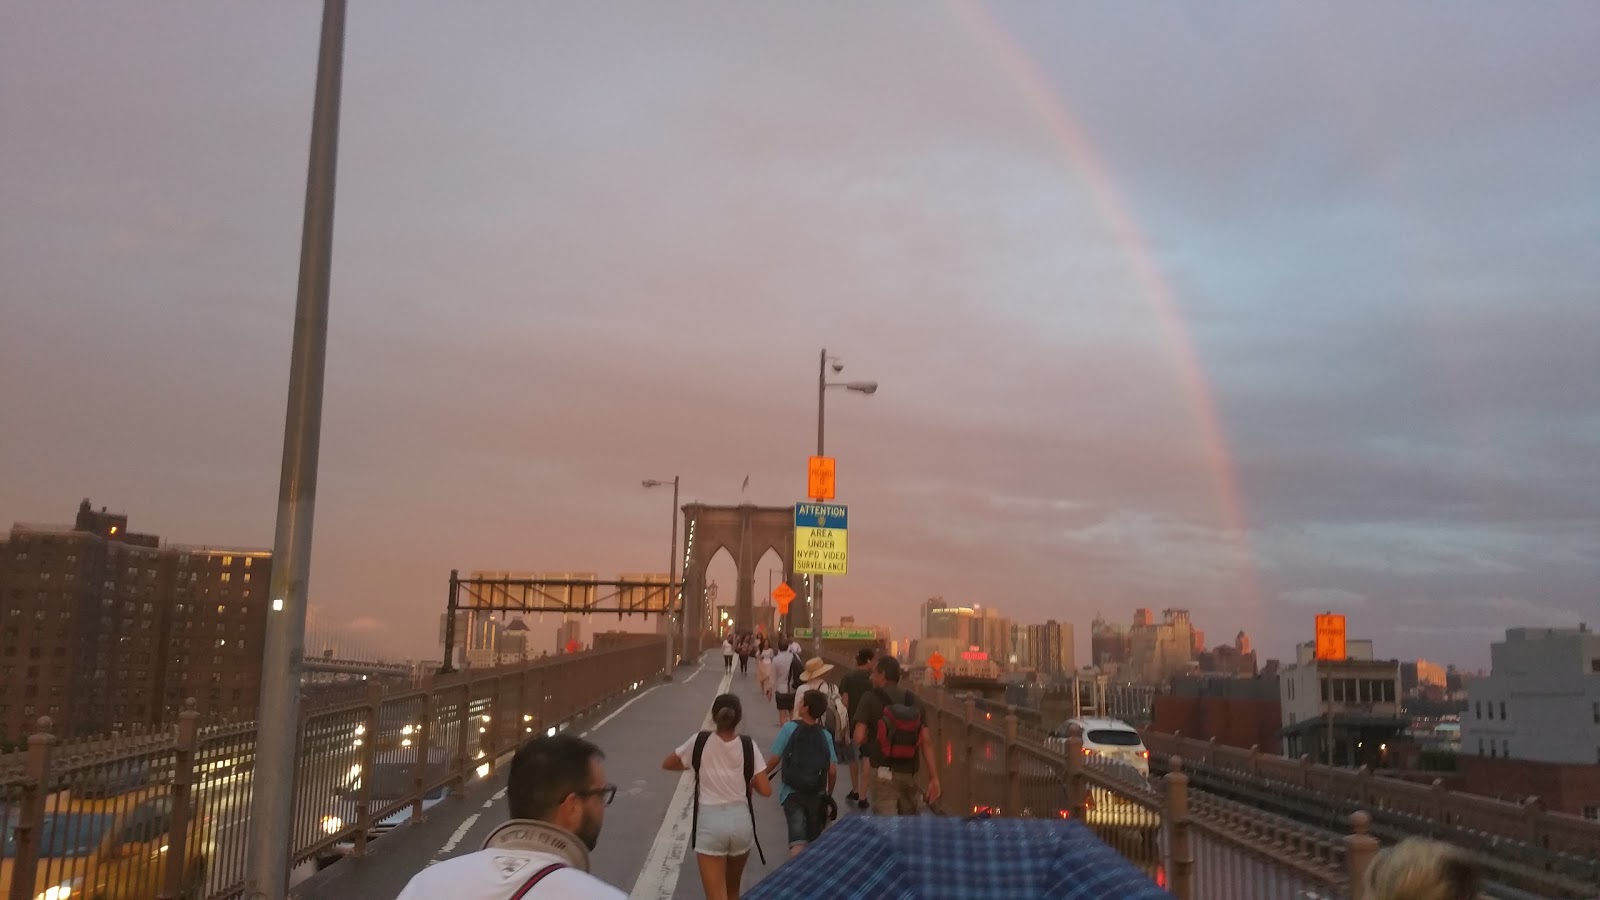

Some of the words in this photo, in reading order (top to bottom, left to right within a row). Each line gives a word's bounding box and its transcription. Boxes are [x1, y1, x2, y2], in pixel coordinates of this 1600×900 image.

[799, 505, 846, 517] ATTENTION
[810, 528, 834, 538] AREA
[808, 539, 836, 549] UNDER
[797, 549, 820, 560] NYPD
[823, 551, 846, 561] VIDEO
[797, 561, 845, 571] SURVEILLANCE
